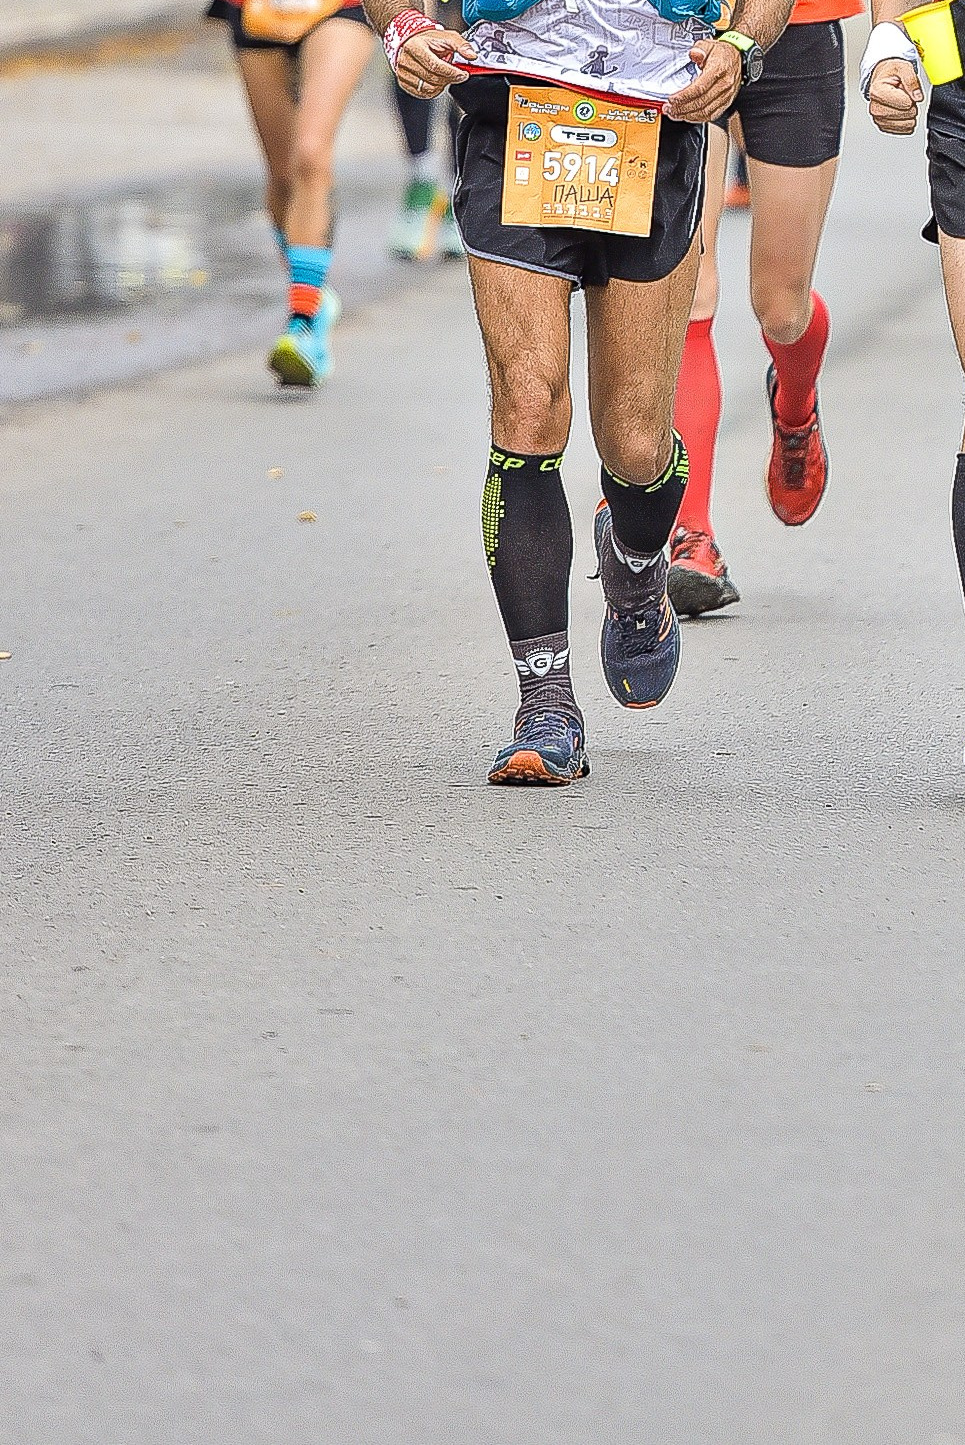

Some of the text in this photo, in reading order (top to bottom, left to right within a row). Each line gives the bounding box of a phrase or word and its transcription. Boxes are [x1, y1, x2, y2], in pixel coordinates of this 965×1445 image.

[598, 113, 633, 122] TRAIL
[542, 151, 619, 187] 5914
[554, 184, 614, 208] ПАША
